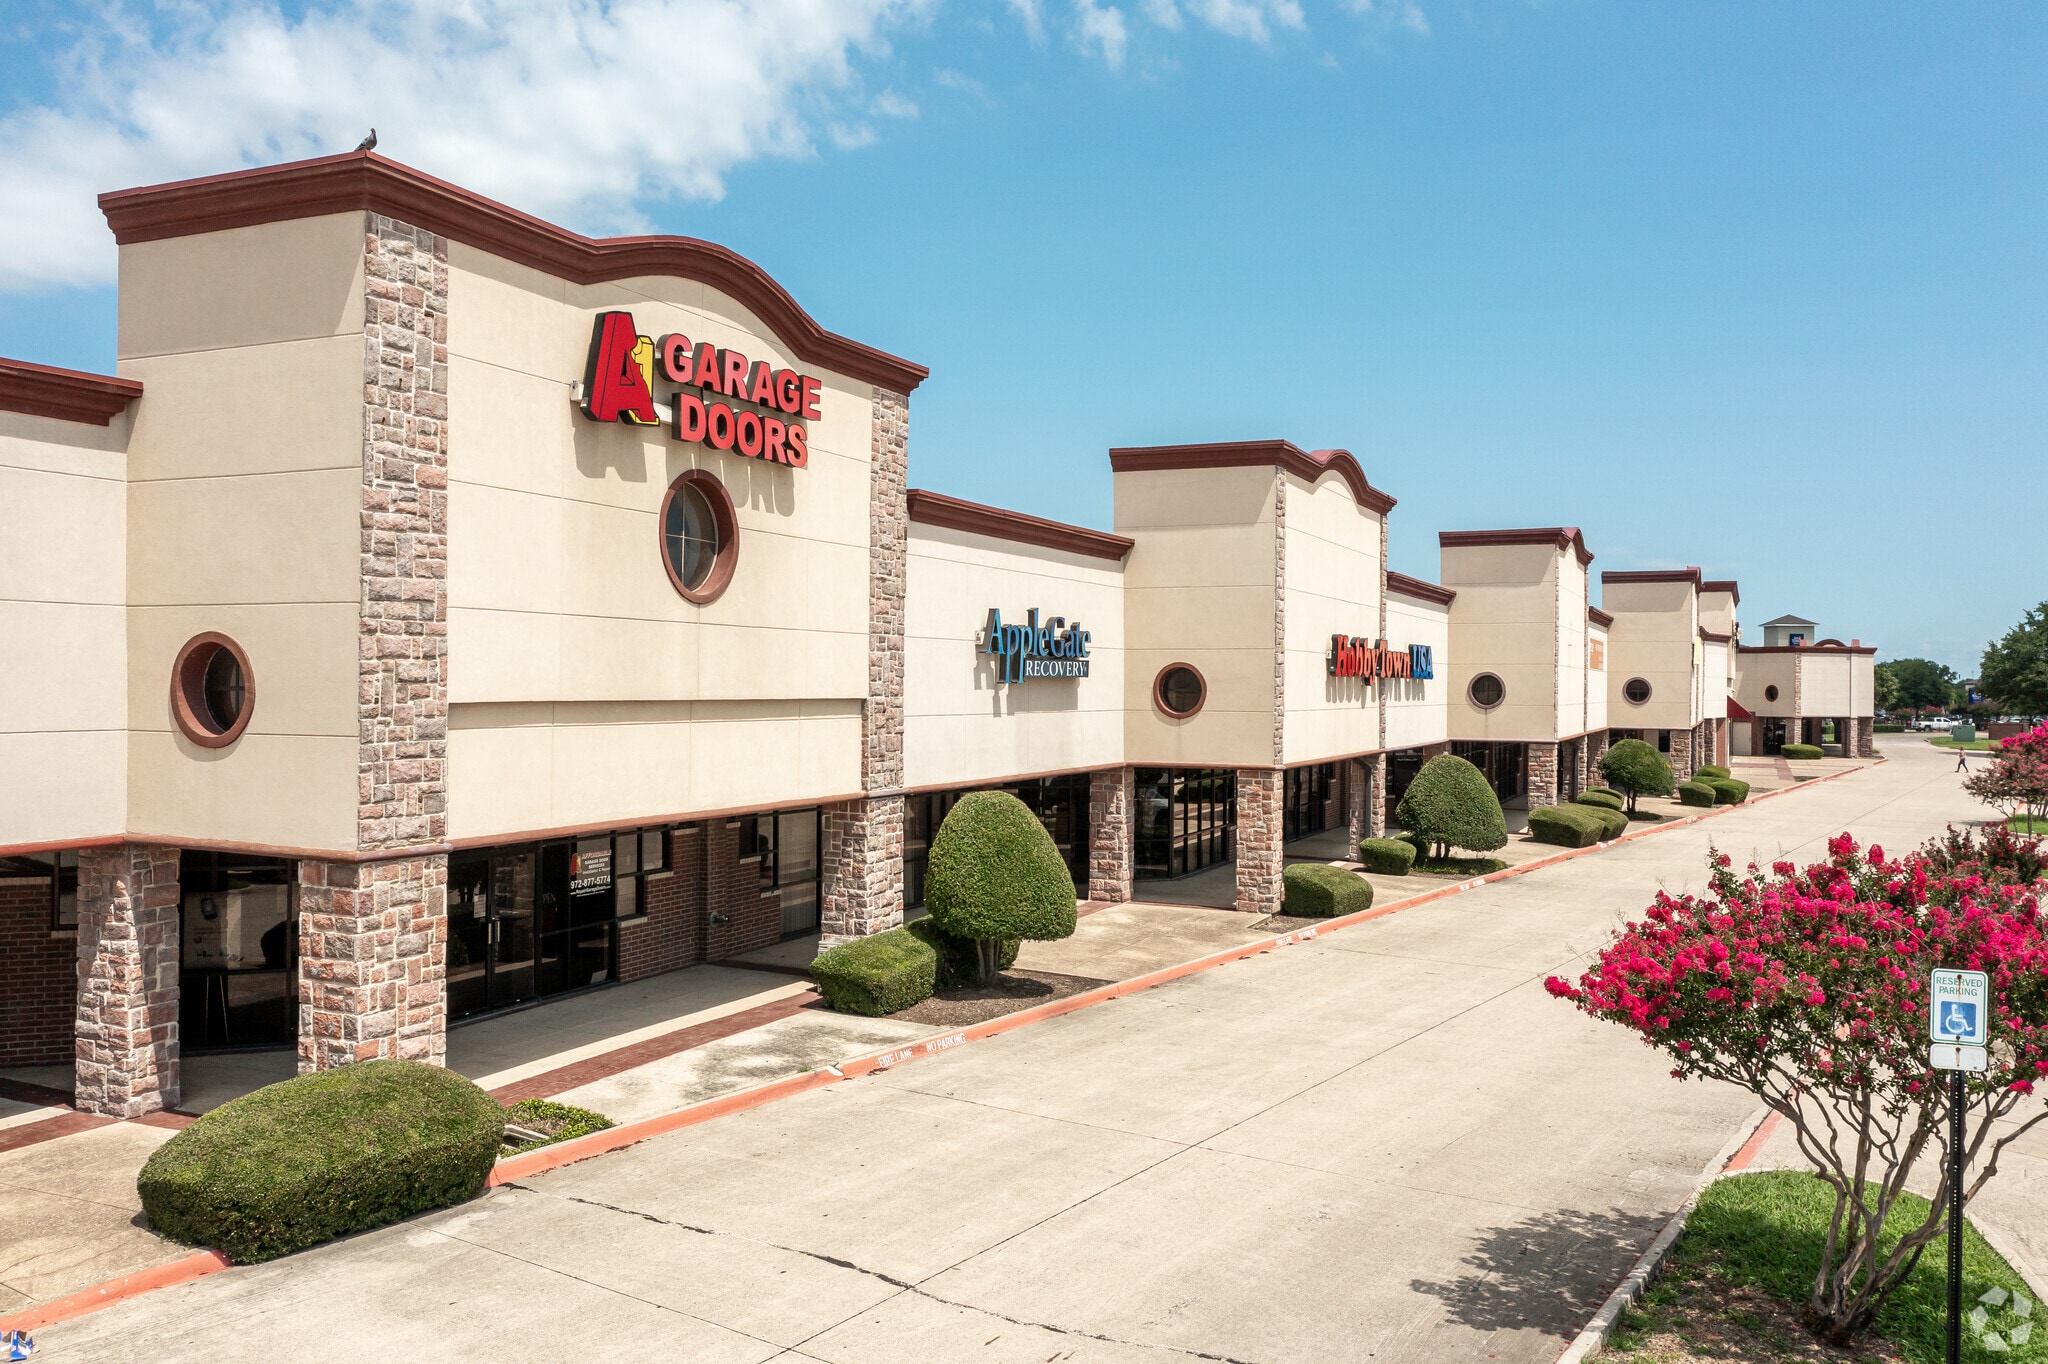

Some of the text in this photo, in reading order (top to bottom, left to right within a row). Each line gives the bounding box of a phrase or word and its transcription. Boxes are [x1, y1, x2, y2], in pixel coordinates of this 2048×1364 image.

[656, 333, 821, 421] GARAGE
[672, 392, 808, 468] DOORS
[979, 607, 1091, 684] AppleGate
[1409, 644, 1434, 680] USA
[1025, 660, 1084, 677] RECOVERY
[570, 875, 611, 889] 972-877-5774
[1936, 976, 1983, 988] RESERVED
[1939, 986, 1978, 997] PARKING
[878, 1033, 967, 1067] FIRE LANE NO PARKING
